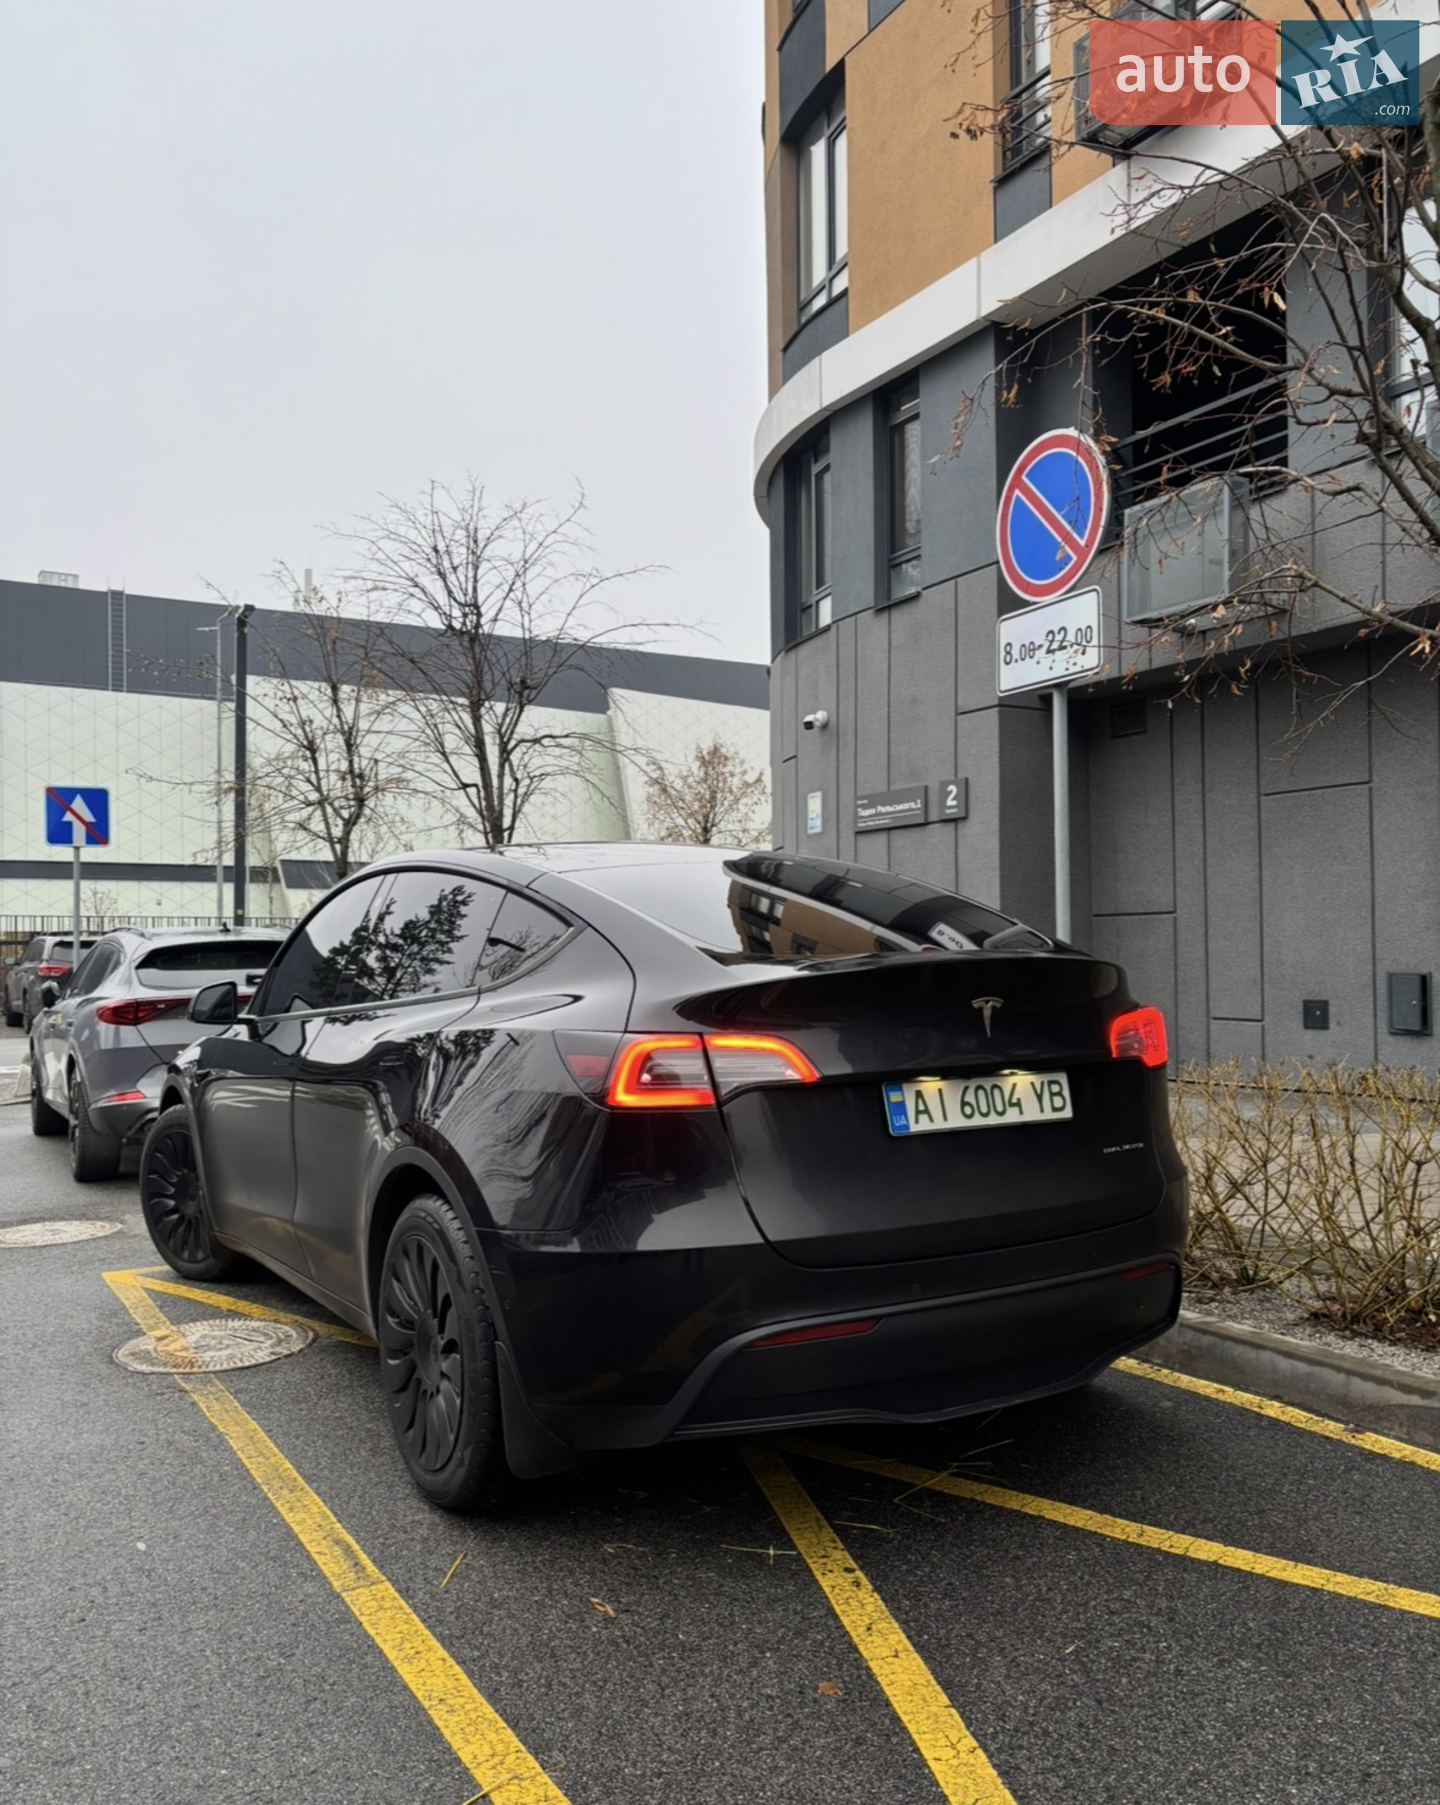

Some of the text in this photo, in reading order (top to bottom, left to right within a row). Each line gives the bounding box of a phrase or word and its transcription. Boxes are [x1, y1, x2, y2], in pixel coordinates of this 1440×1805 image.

[946, 784, 958, 807] 2
[914, 1079, 1067, 1125] AI 6004 YB
[892, 1115, 908, 1126] UA
